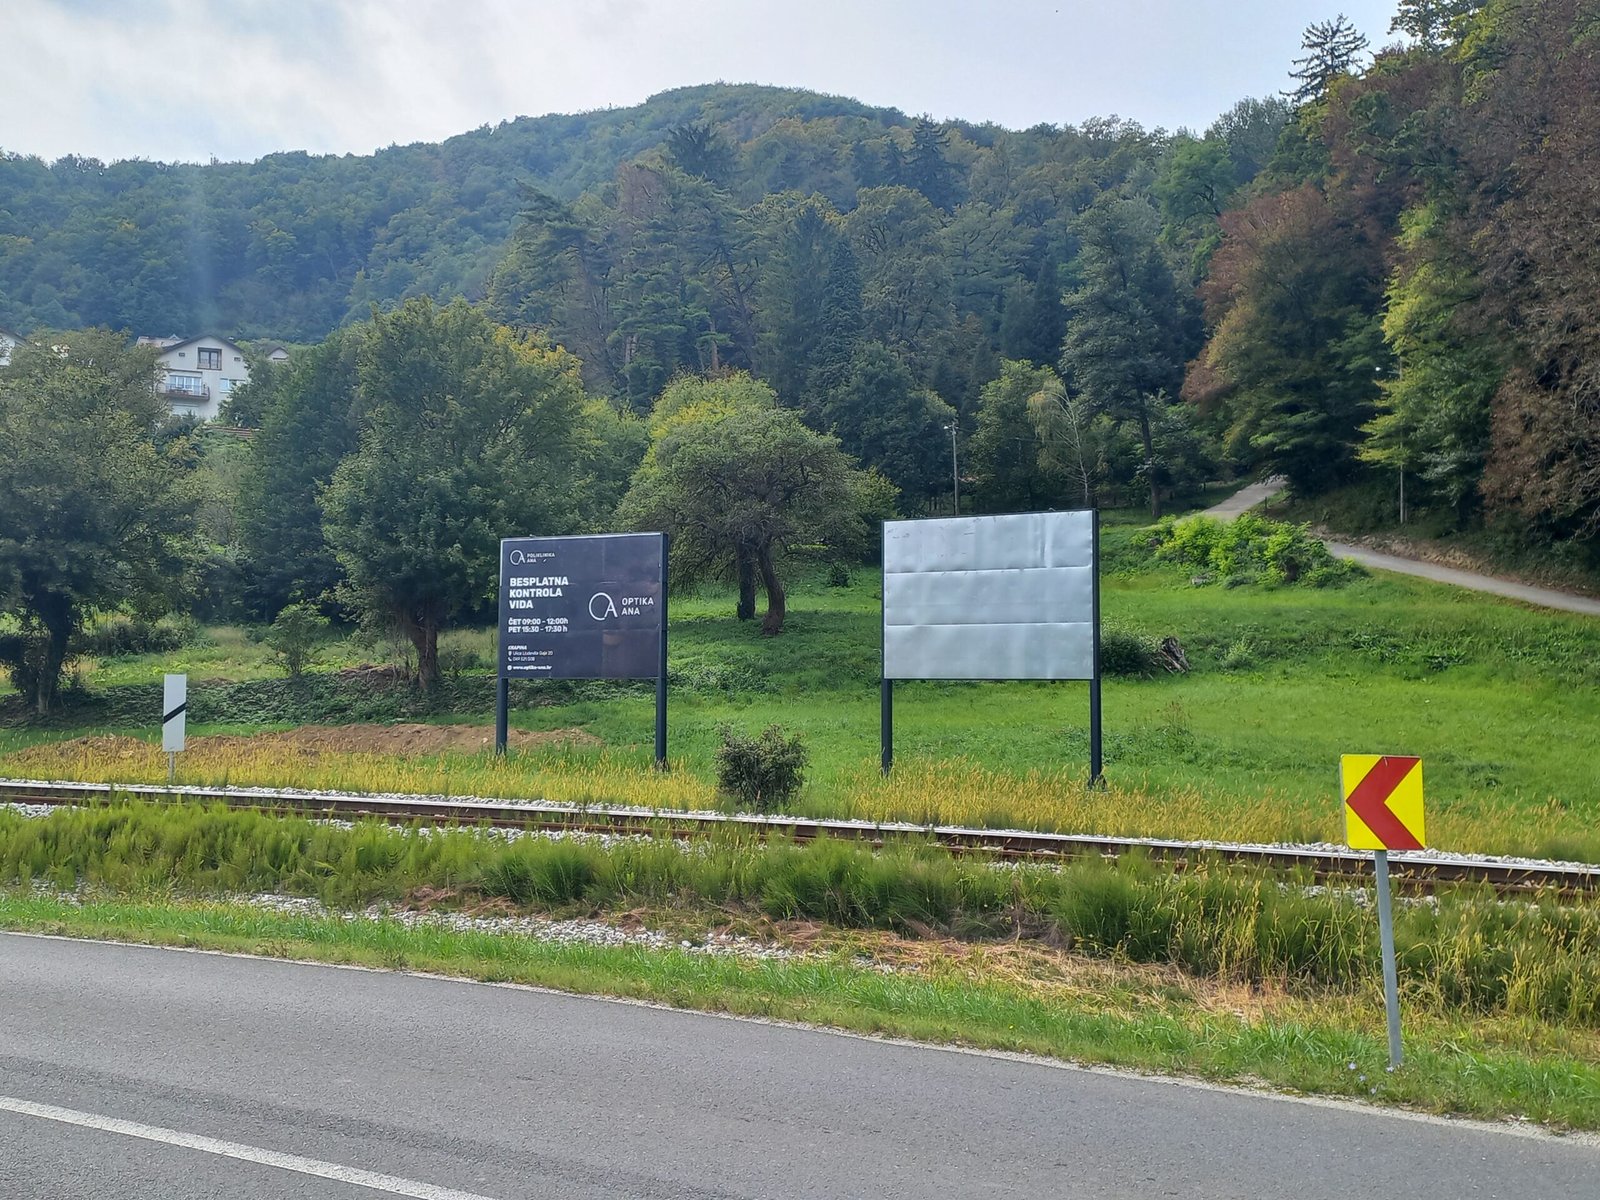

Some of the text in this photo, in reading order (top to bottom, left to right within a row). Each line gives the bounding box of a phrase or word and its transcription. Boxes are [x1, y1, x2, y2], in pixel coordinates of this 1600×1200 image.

[510, 576, 569, 586] BESPLATNA
[509, 588, 562, 598] KONTROLA
[509, 600, 534, 609] VIDA
[621, 596, 654, 606] OPTIKA
[621, 607, 640, 616] ANA
[508, 616, 522, 626] ČET
